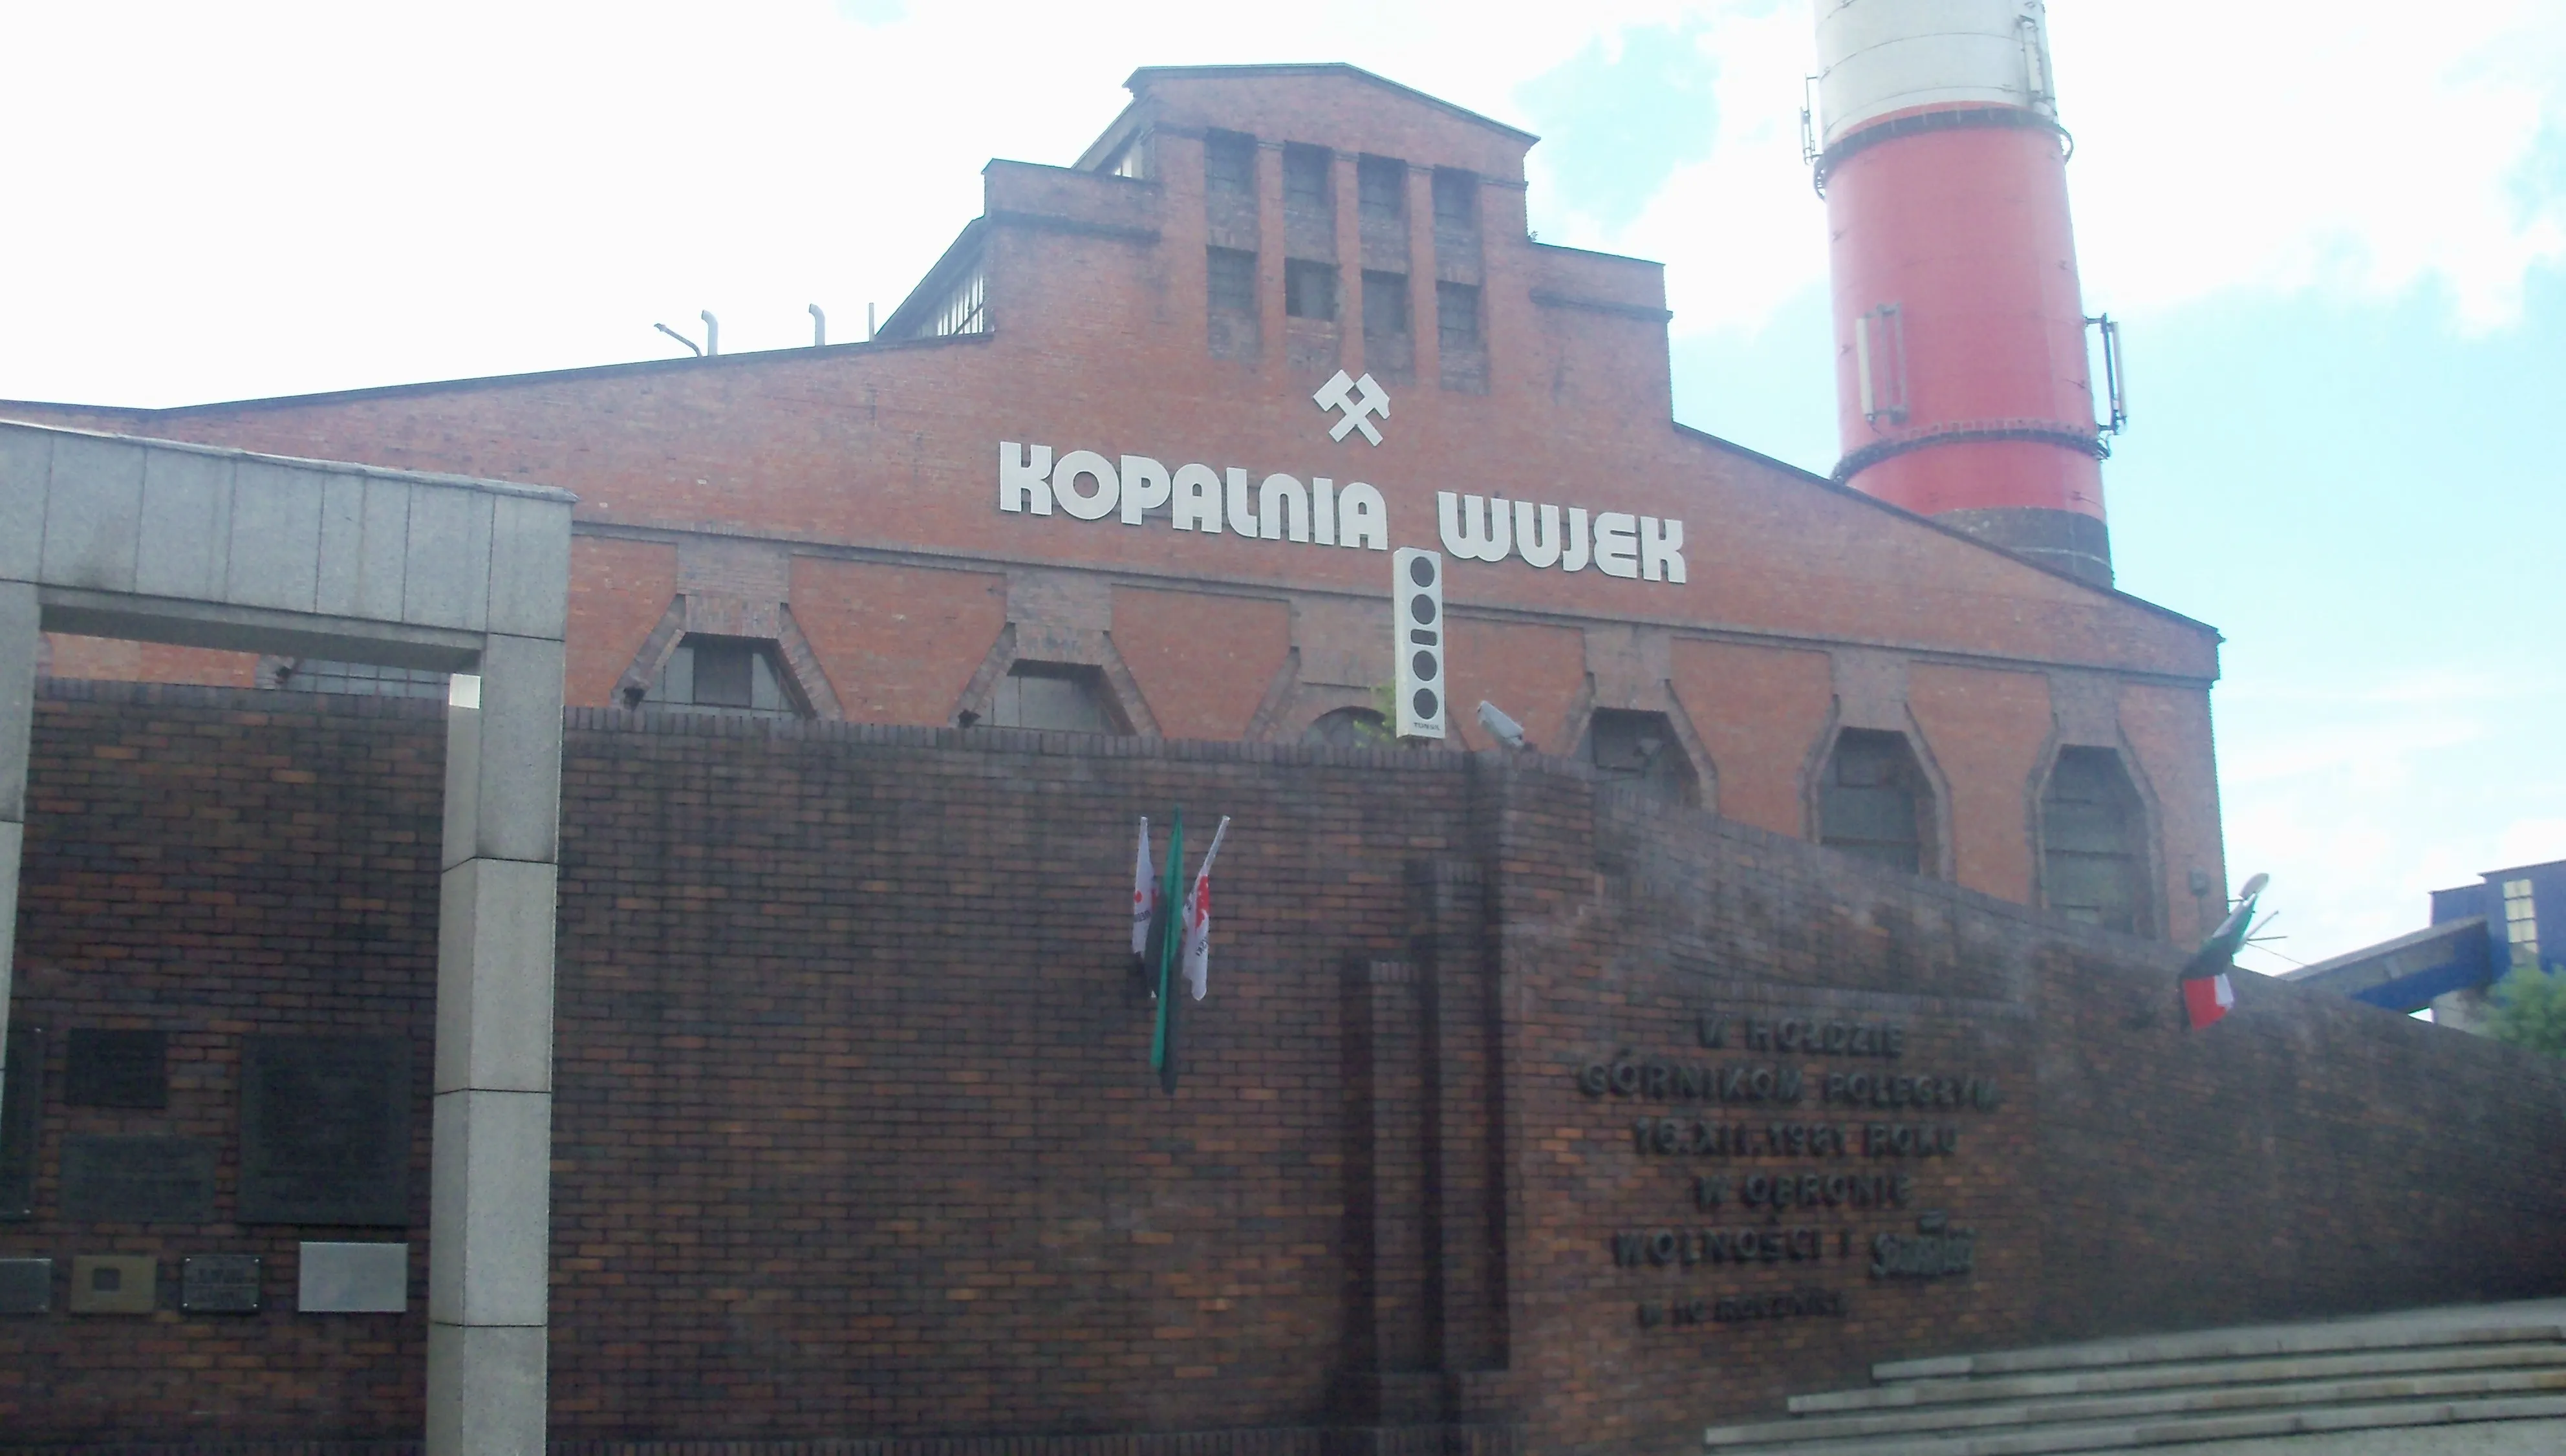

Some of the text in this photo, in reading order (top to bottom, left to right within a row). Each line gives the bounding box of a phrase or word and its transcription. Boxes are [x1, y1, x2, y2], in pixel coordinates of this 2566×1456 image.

[999, 440, 1687, 583] KOPALNIA WUJEK
[1579, 1048, 1802, 1102] GÓRNIKOM
[1865, 1122, 1958, 1157] ROKU
[1696, 1174, 1730, 1208] W
